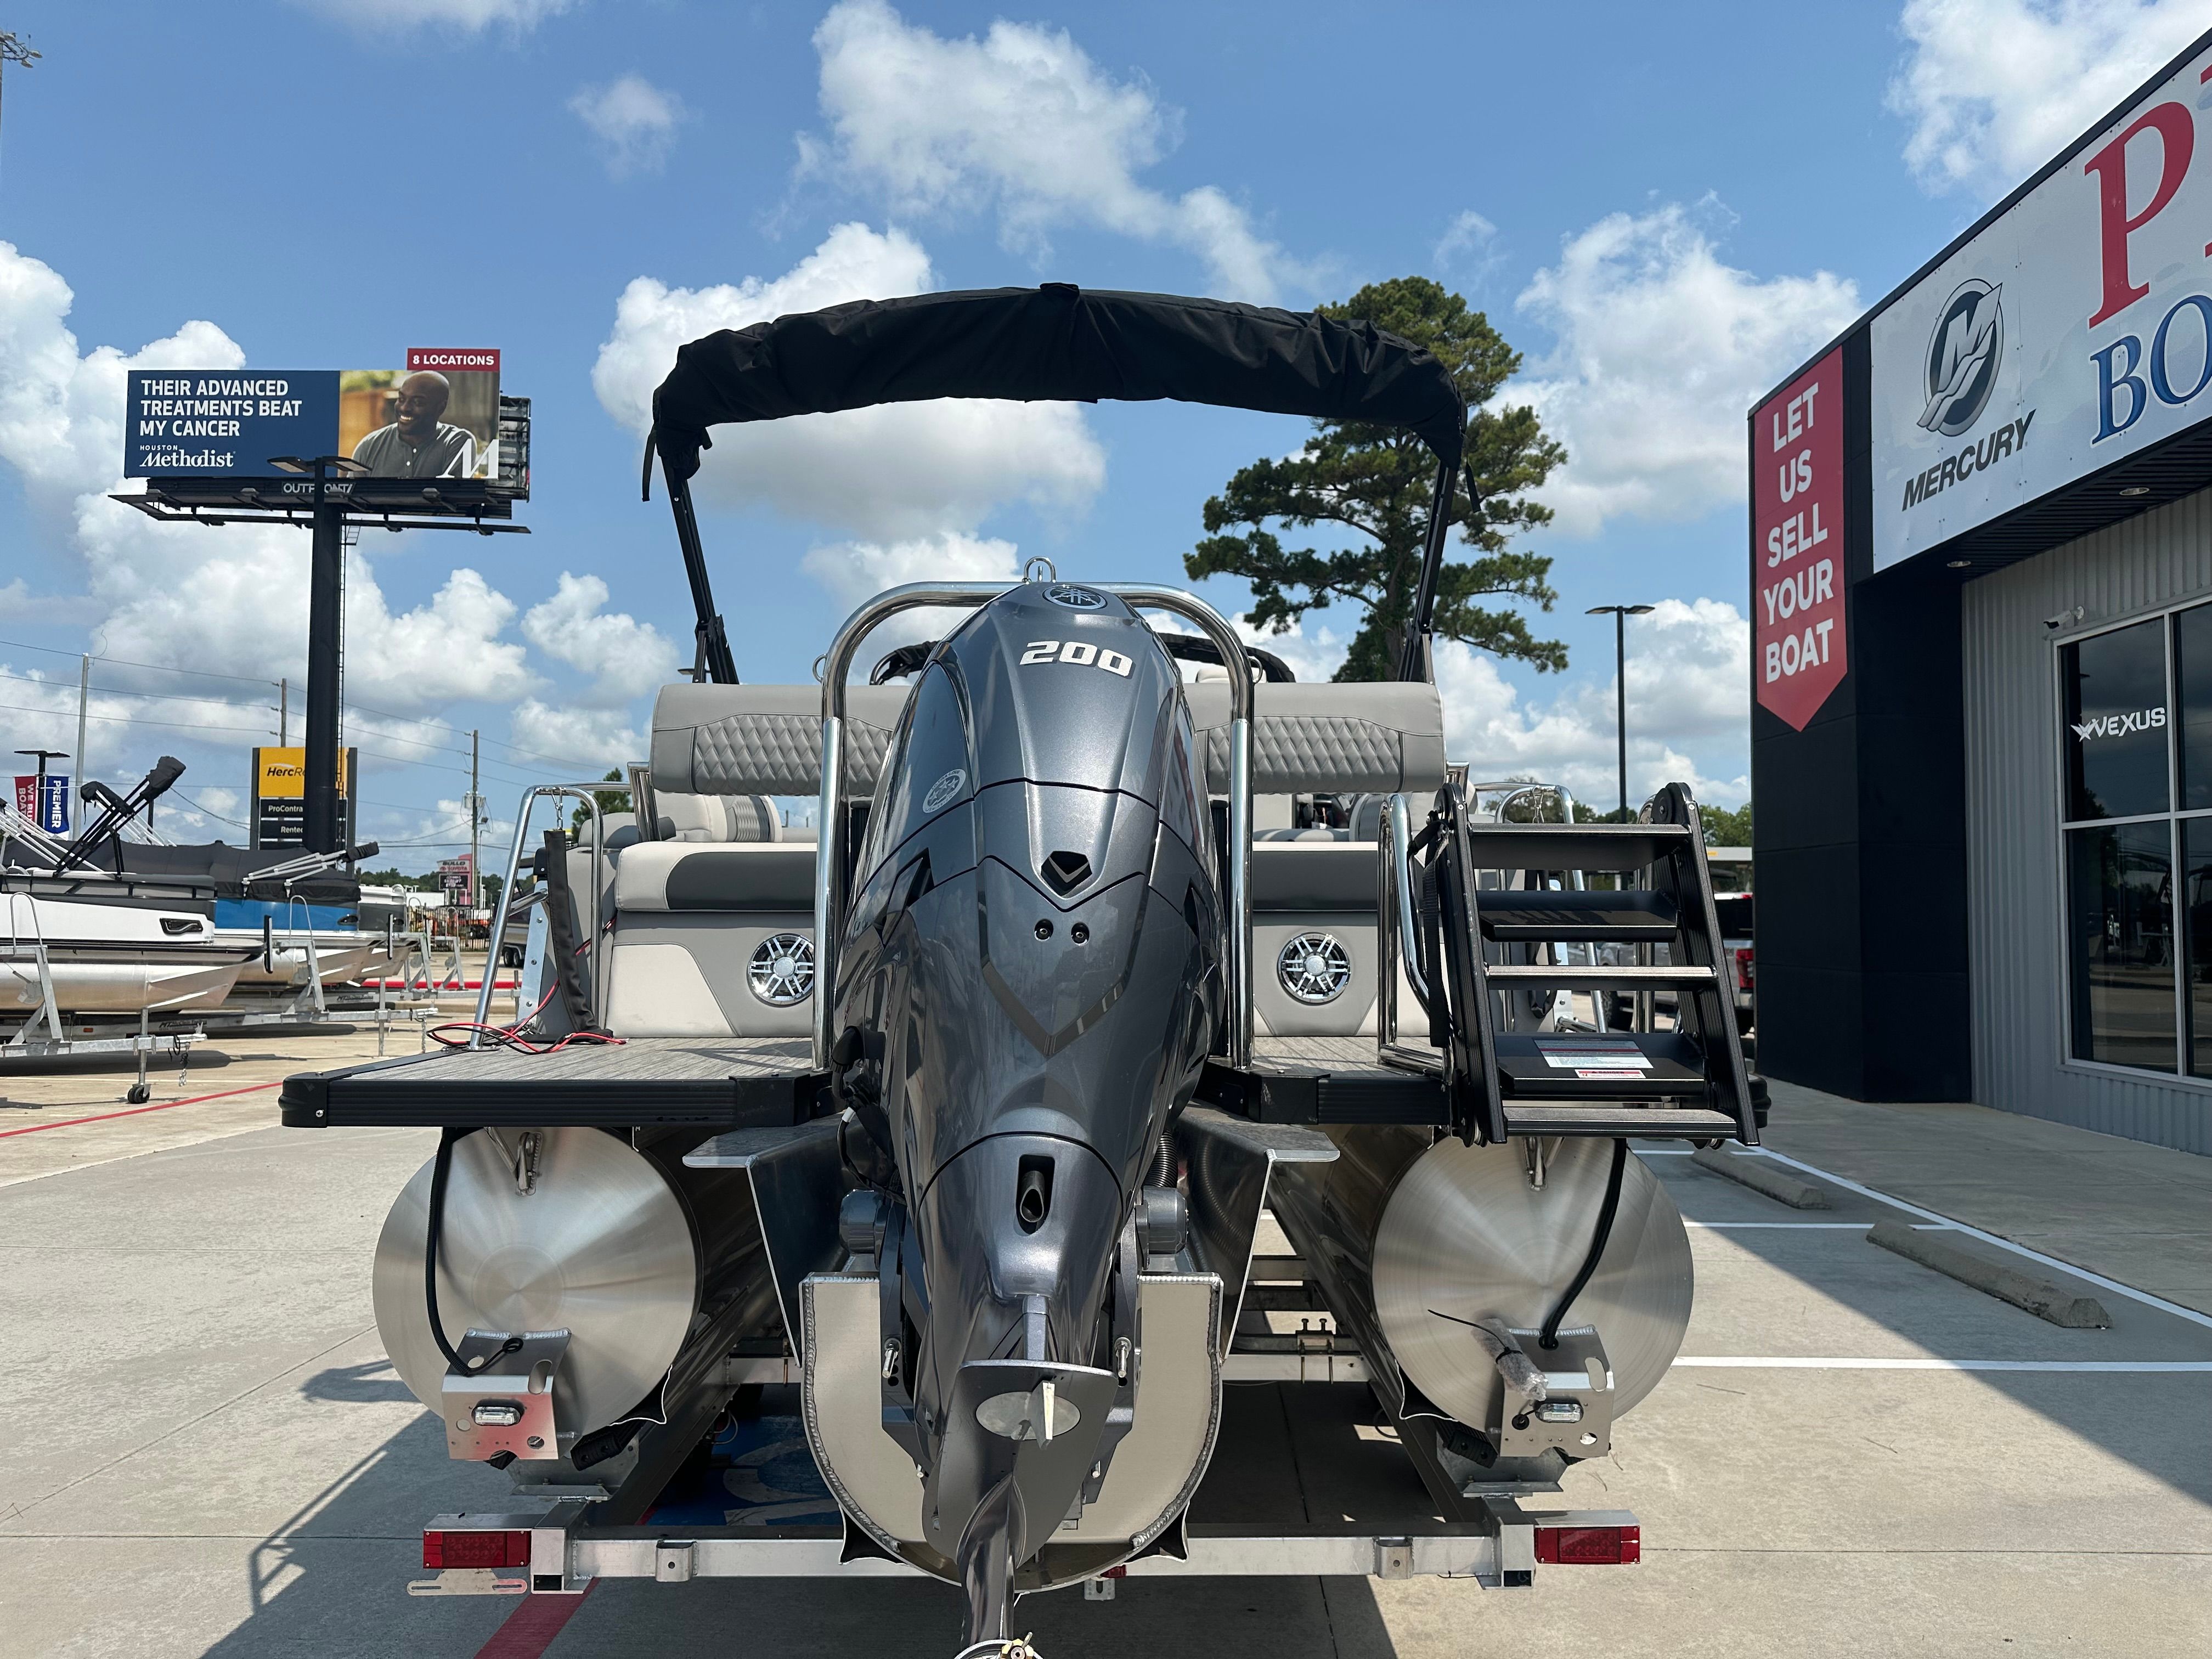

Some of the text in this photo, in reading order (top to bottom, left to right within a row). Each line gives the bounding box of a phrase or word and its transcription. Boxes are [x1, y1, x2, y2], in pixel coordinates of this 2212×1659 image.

[2085, 64, 2212, 329] P
[413, 354, 494, 365] 8 LOCATIONS
[140, 379, 289, 396] THEIR ADVANCED
[140, 400, 302, 416] TREATMENTS BEAT
[1773, 382, 1819, 453] LET
[139, 420, 240, 437] MY CANCER
[139, 449, 234, 467] Methodist
[1779, 449, 1813, 503] US
[1901, 408, 2037, 512] MERCURY
[1768, 502, 1828, 568] SELL
[1763, 558, 1834, 626] YOUR
[1019, 640, 1134, 677] 200
[1766, 618, 1834, 684] BOAT
[2091, 707, 2166, 738] VEXUS
[18, 787, 27, 815] BOAT
[27, 783, 34, 801] WE
[52, 780, 61, 828] PREMIER
